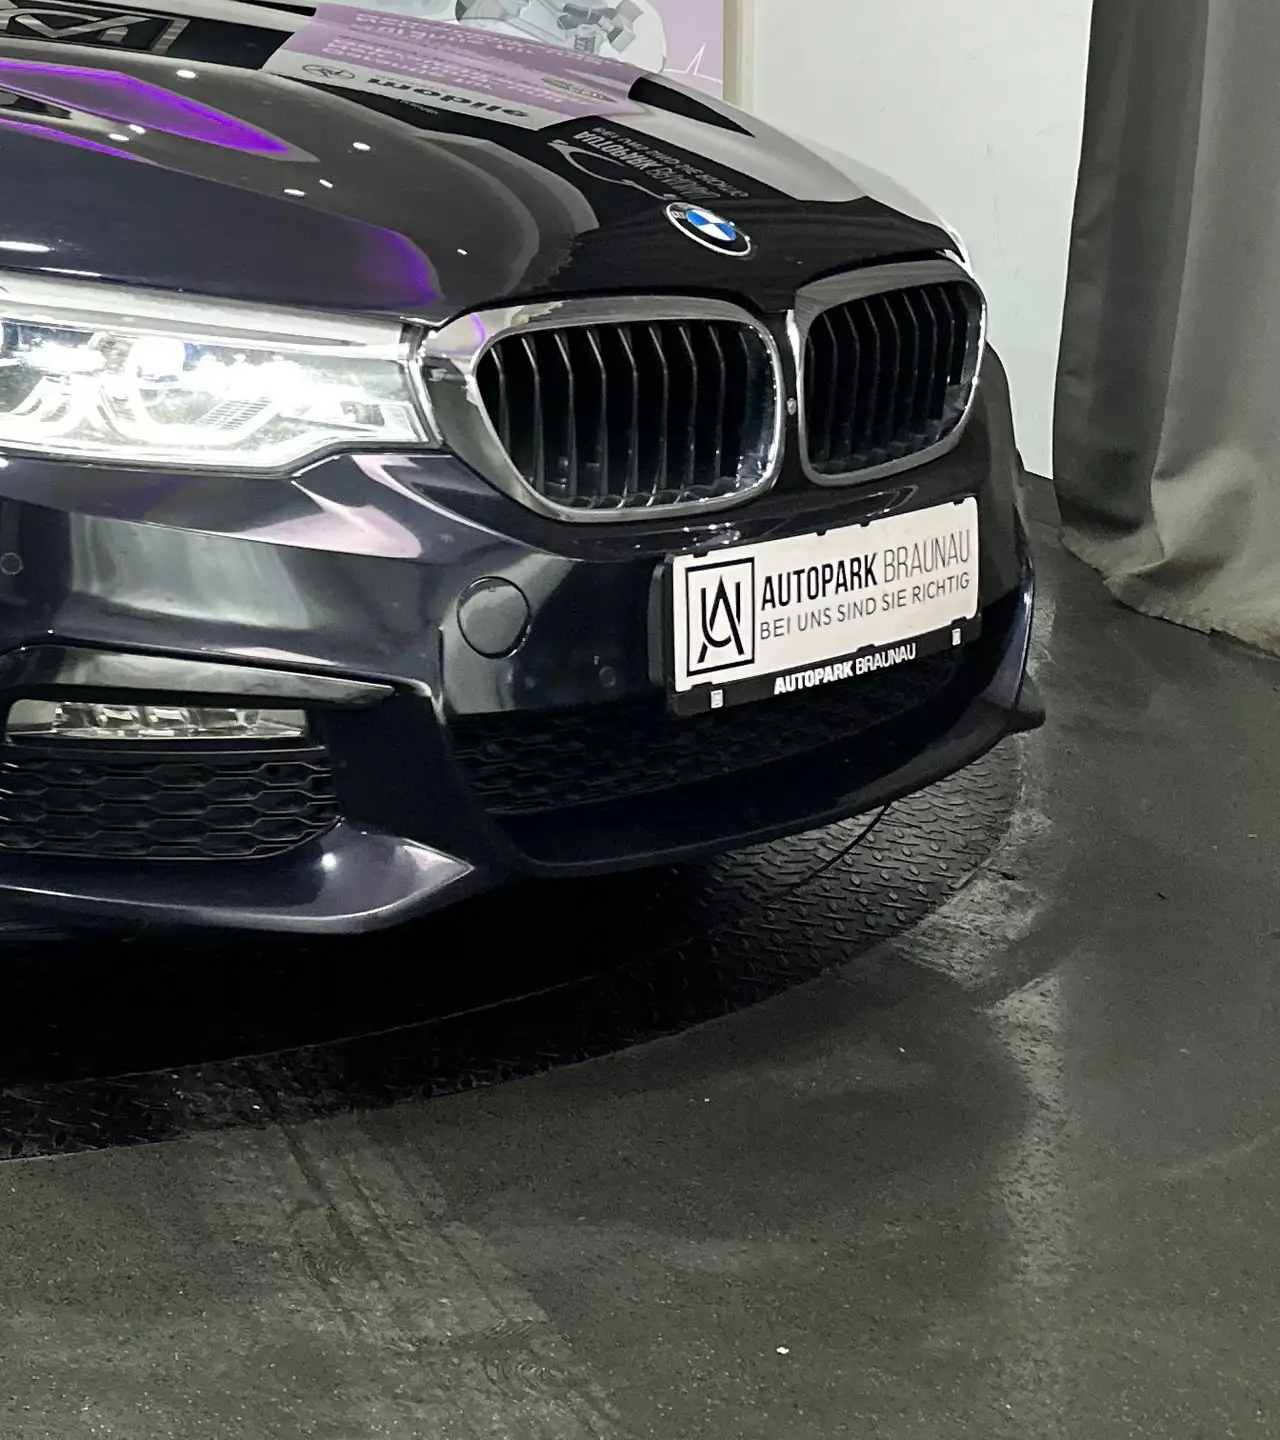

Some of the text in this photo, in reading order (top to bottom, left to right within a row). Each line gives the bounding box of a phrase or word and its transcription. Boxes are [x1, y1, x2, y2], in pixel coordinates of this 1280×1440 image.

[760, 528, 971, 611] AUTOPARK BRAUNAU
[760, 571, 971, 641] BEI UNS SIND SIE RICHTIG
[773, 642, 917, 695] AUTOPARK BRAUNAU
